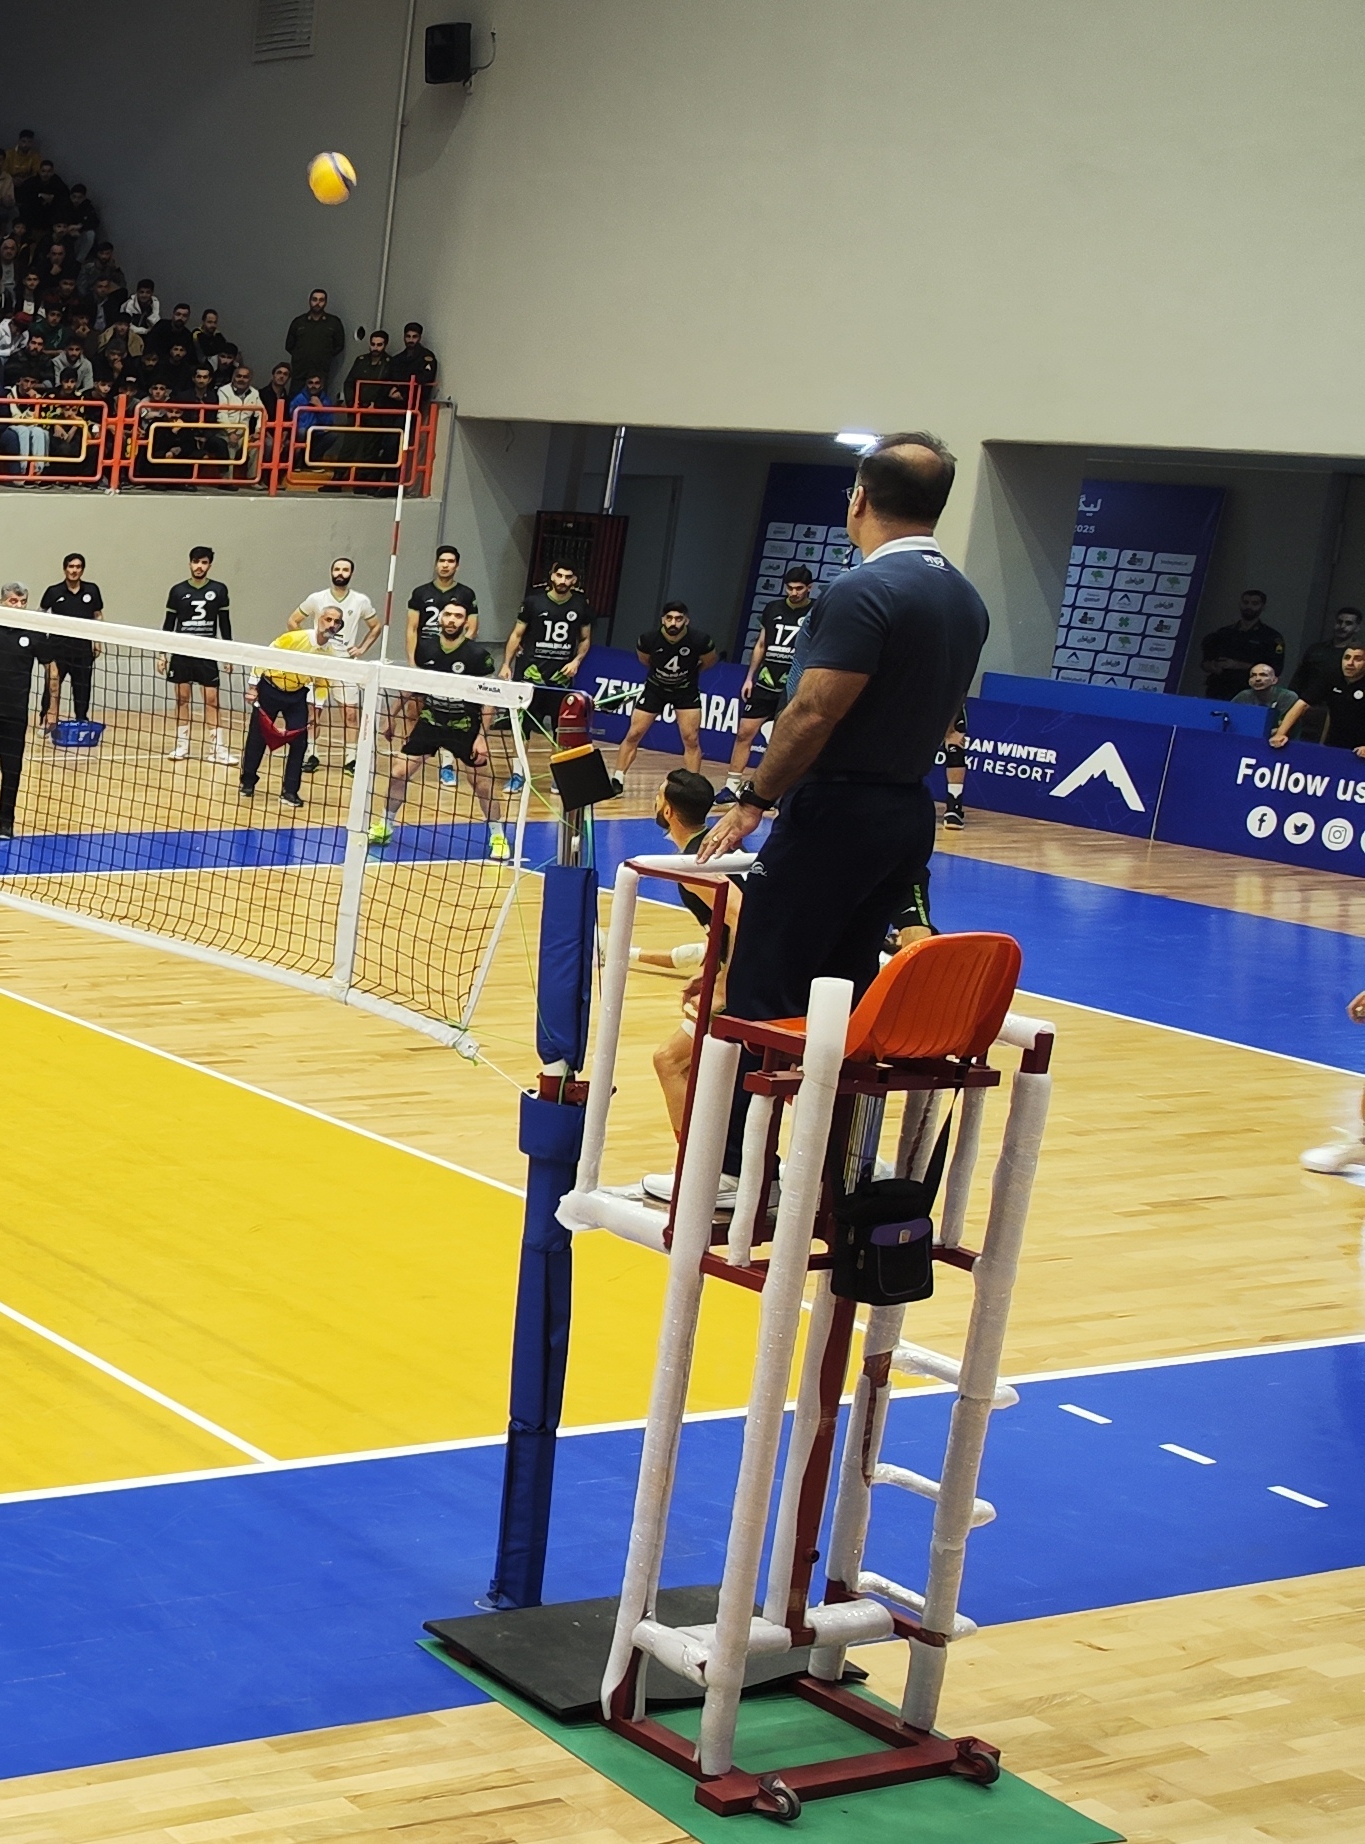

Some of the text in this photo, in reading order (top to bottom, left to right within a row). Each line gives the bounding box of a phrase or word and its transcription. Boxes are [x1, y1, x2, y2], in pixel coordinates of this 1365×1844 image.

[1075, 524, 1096, 534] 025
[190, 600, 207, 620] 3
[543, 620, 569, 642] 18
[774, 623, 801, 646] 17
[663, 655, 680, 673] 4
[996, 741, 1057, 764] WINTER
[982, 758, 1055, 783] RESORT
[1236, 756, 1365, 804] Follow us
